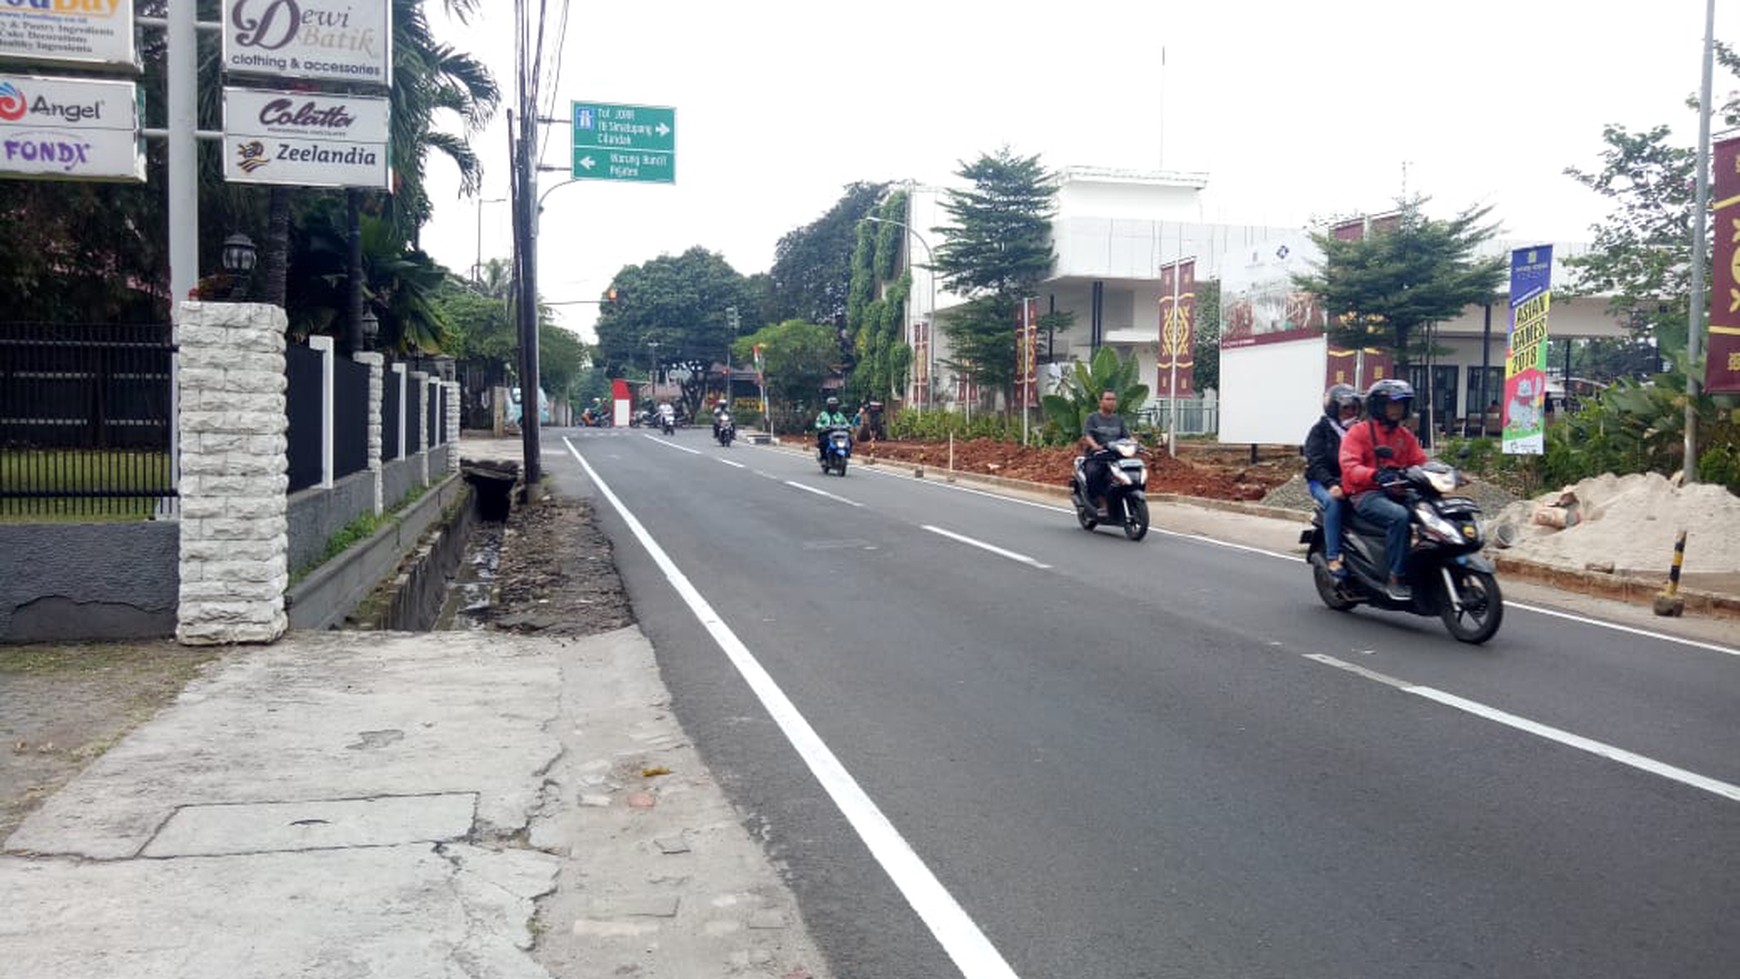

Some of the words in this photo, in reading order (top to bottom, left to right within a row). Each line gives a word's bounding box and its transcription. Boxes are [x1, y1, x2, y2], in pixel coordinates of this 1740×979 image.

[23, 21, 54, 32] Pastry
[58, 24, 114, 36] Ingredients
[28, 31, 87, 43] Decorations
[232, 0, 352, 50] Dewi
[37, 41, 92, 53] Ingredients
[299, 26, 379, 58] Batik
[232, 54, 287, 70] clothing
[290, 57, 300, 69] &
[304, 60, 380, 75] accessories
[29, 95, 100, 122] Angel
[259, 98, 356, 128] Colatta
[276, 143, 376, 165] Zeelandia
[1516, 295, 1546, 325] ASIAN
[1512, 317, 1546, 351] GAMES
[1511, 345, 1537, 374] 2018
